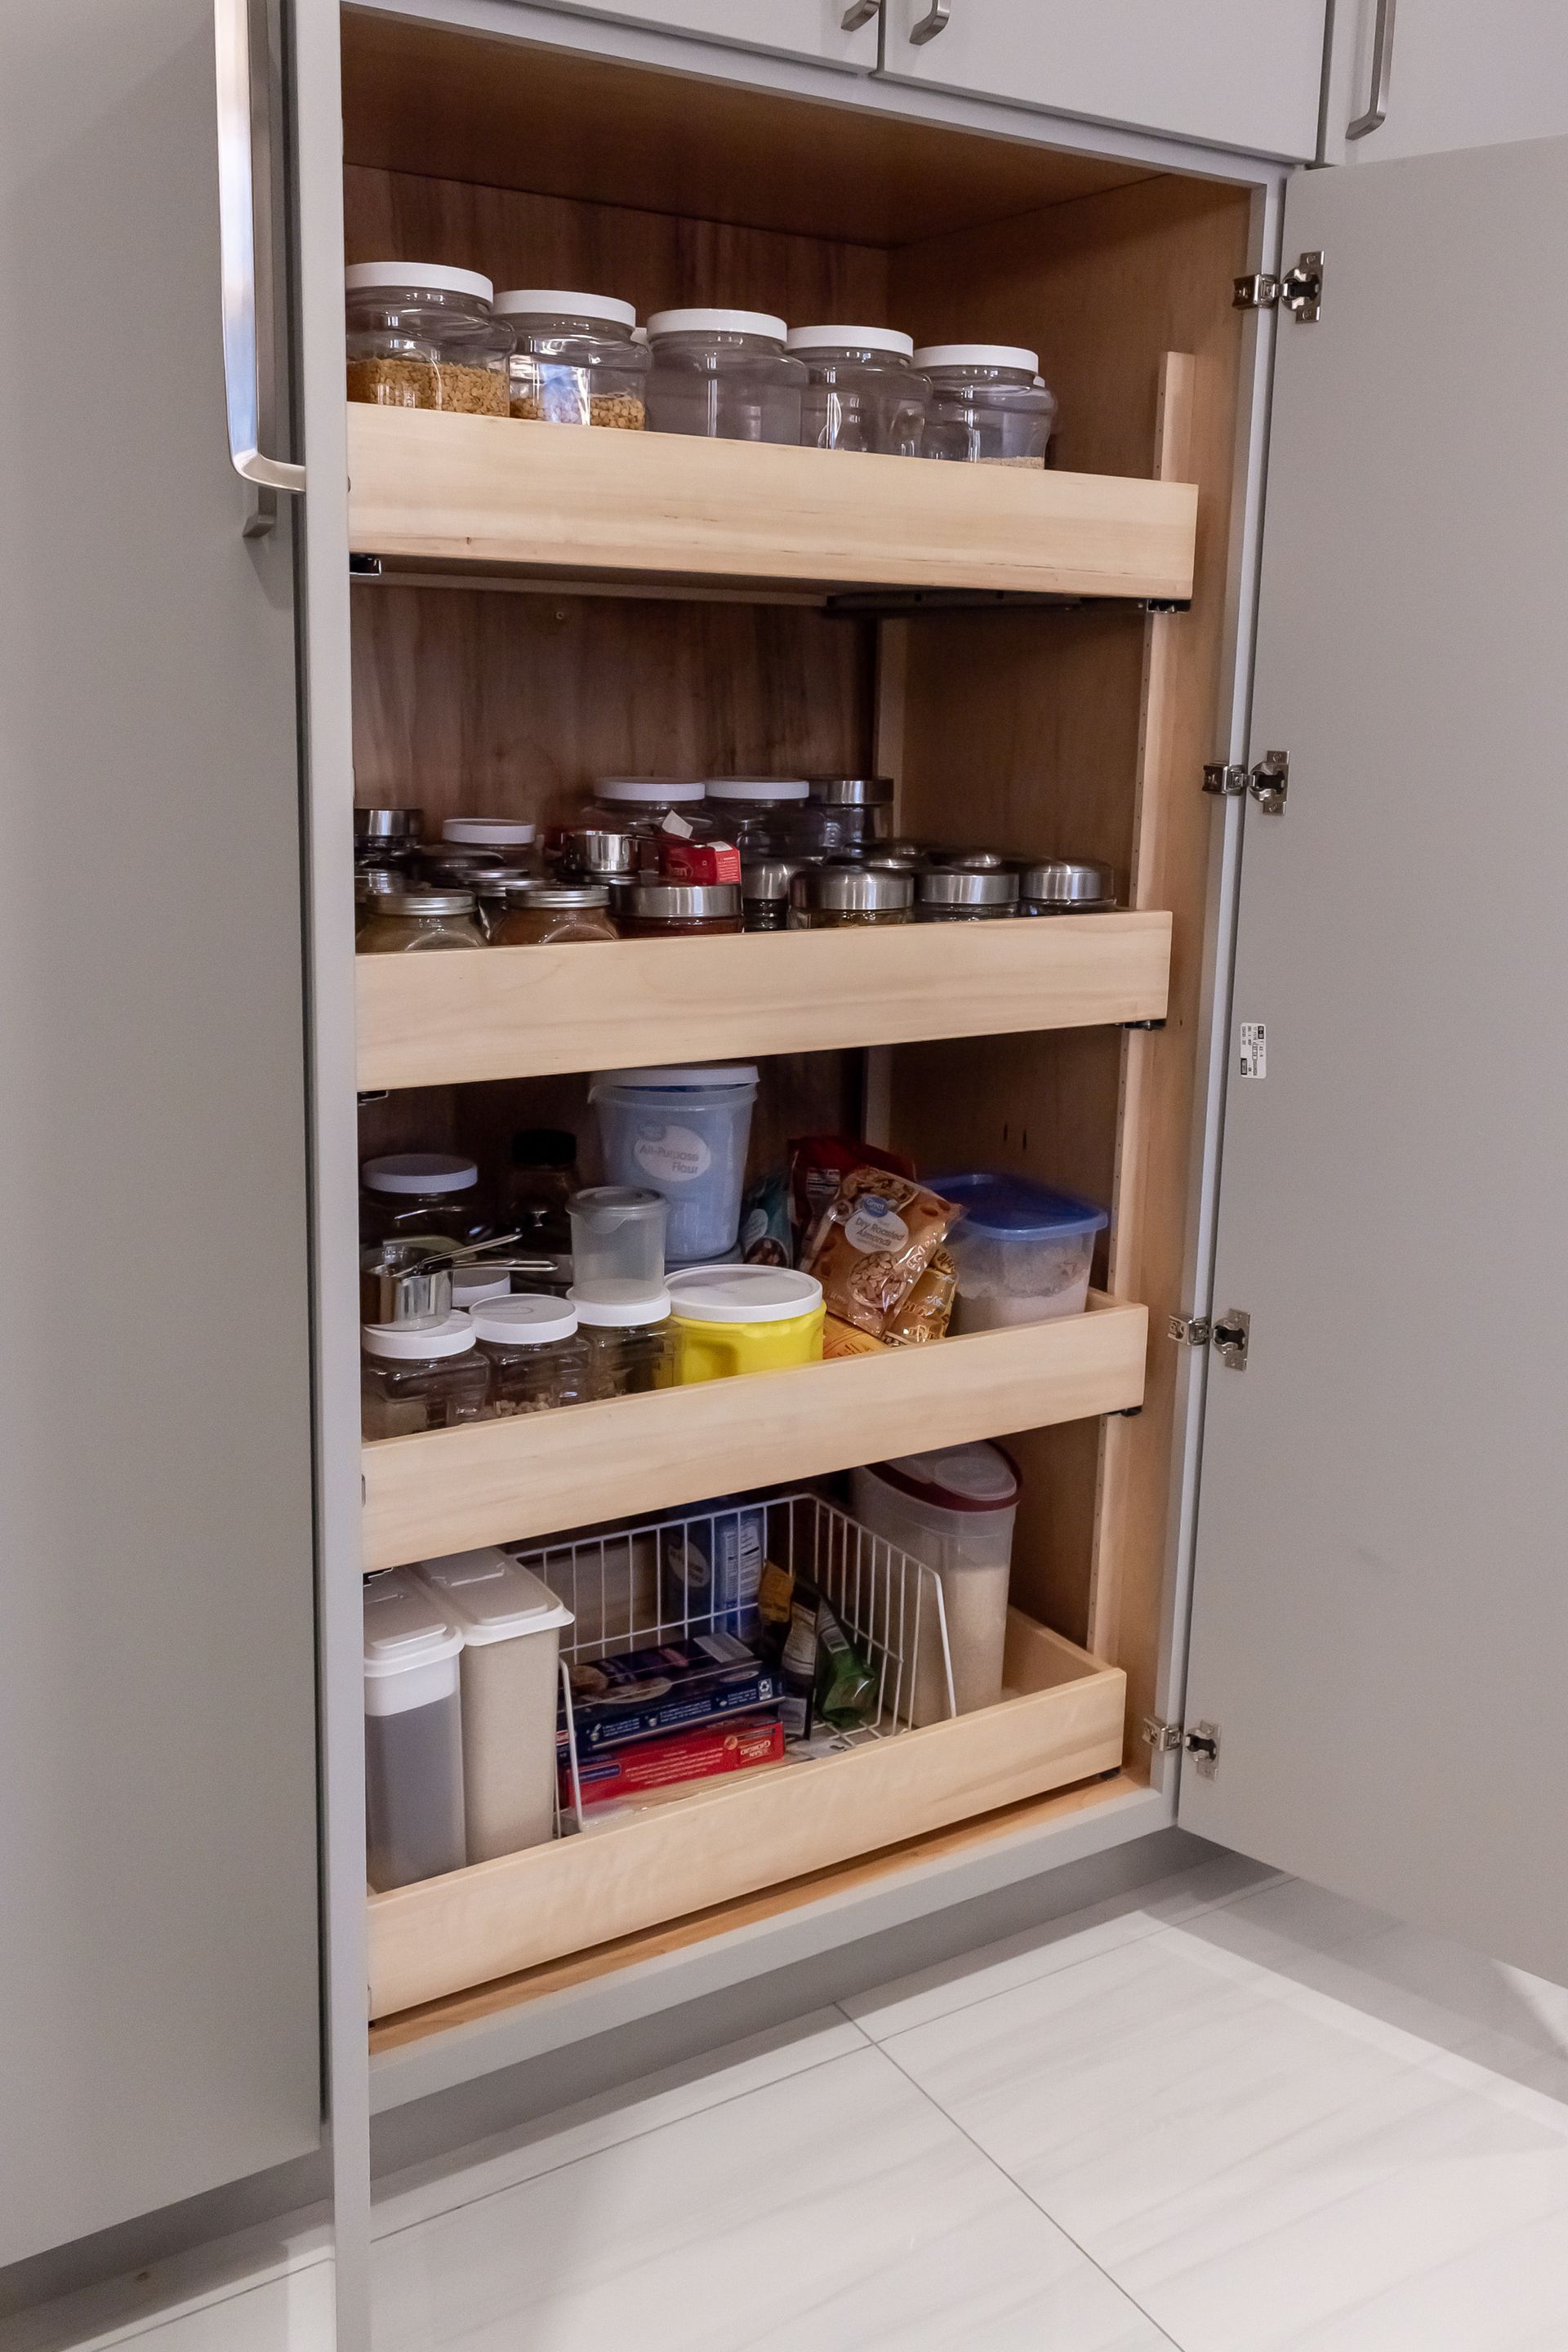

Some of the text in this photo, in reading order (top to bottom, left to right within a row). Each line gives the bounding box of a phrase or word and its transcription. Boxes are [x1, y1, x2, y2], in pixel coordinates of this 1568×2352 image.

[639, 1145, 700, 1161] All-Purpose
[671, 1161, 699, 1174] Flour
[855, 1228, 892, 1247] Almonds
[870, 1223, 906, 1241] Roasted
